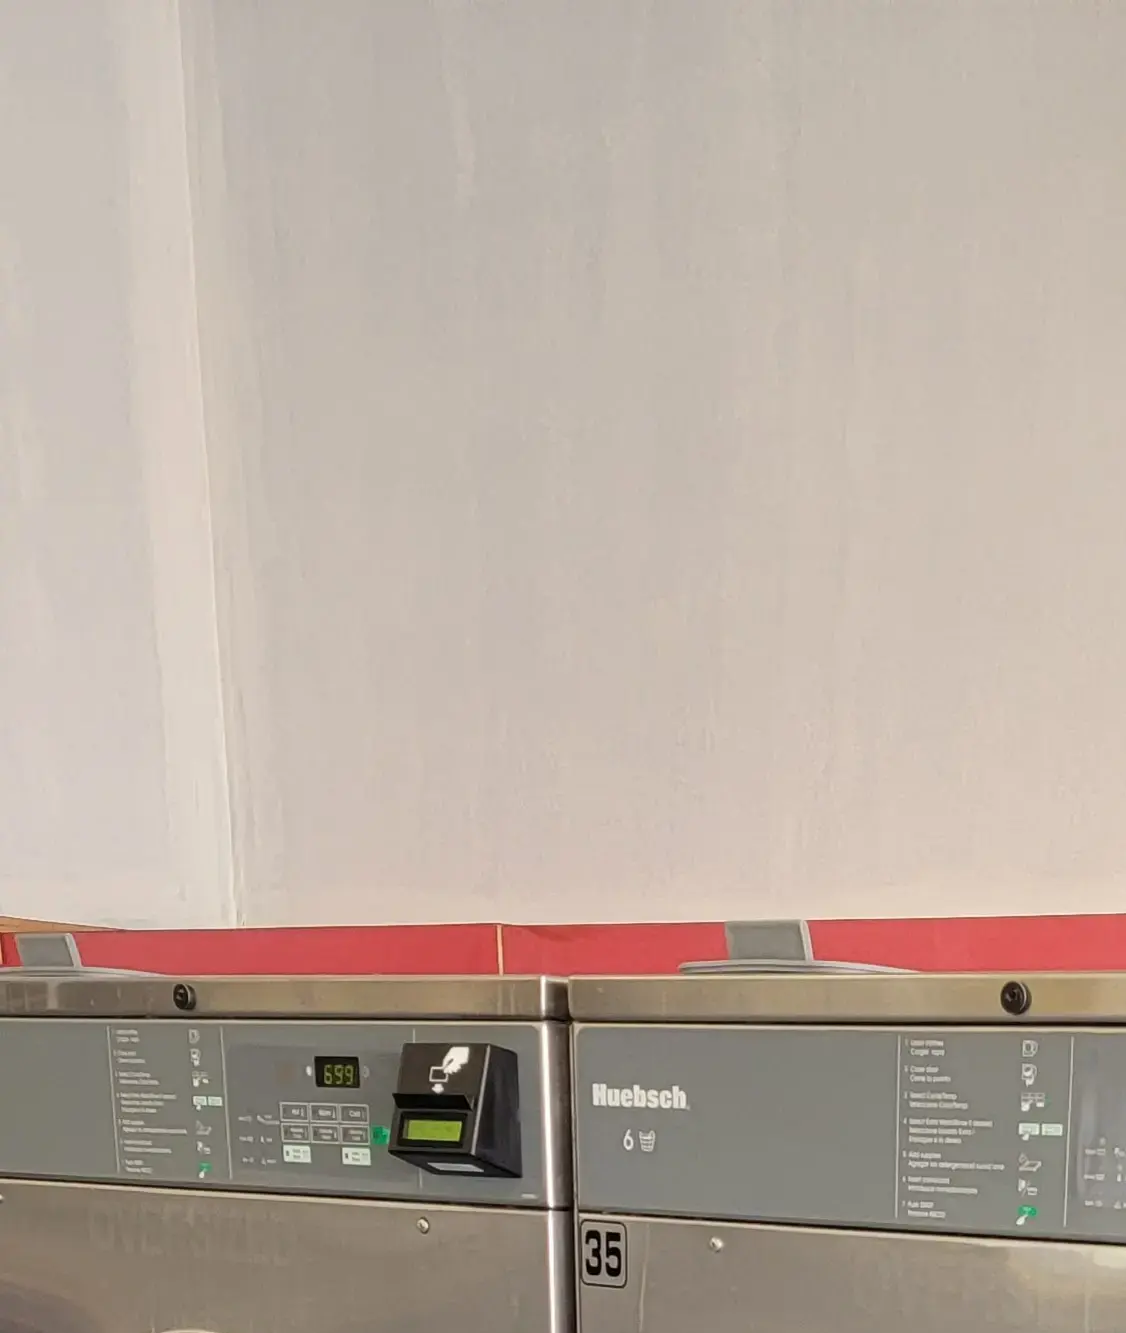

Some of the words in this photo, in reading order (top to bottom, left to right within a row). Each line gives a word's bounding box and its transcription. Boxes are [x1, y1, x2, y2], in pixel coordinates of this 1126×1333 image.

[323, 1064, 354, 1085] 699
[591, 1083, 688, 1110] Huebsch
[623, 1129, 634, 1151] 6
[585, 1229, 622, 1277] 35
